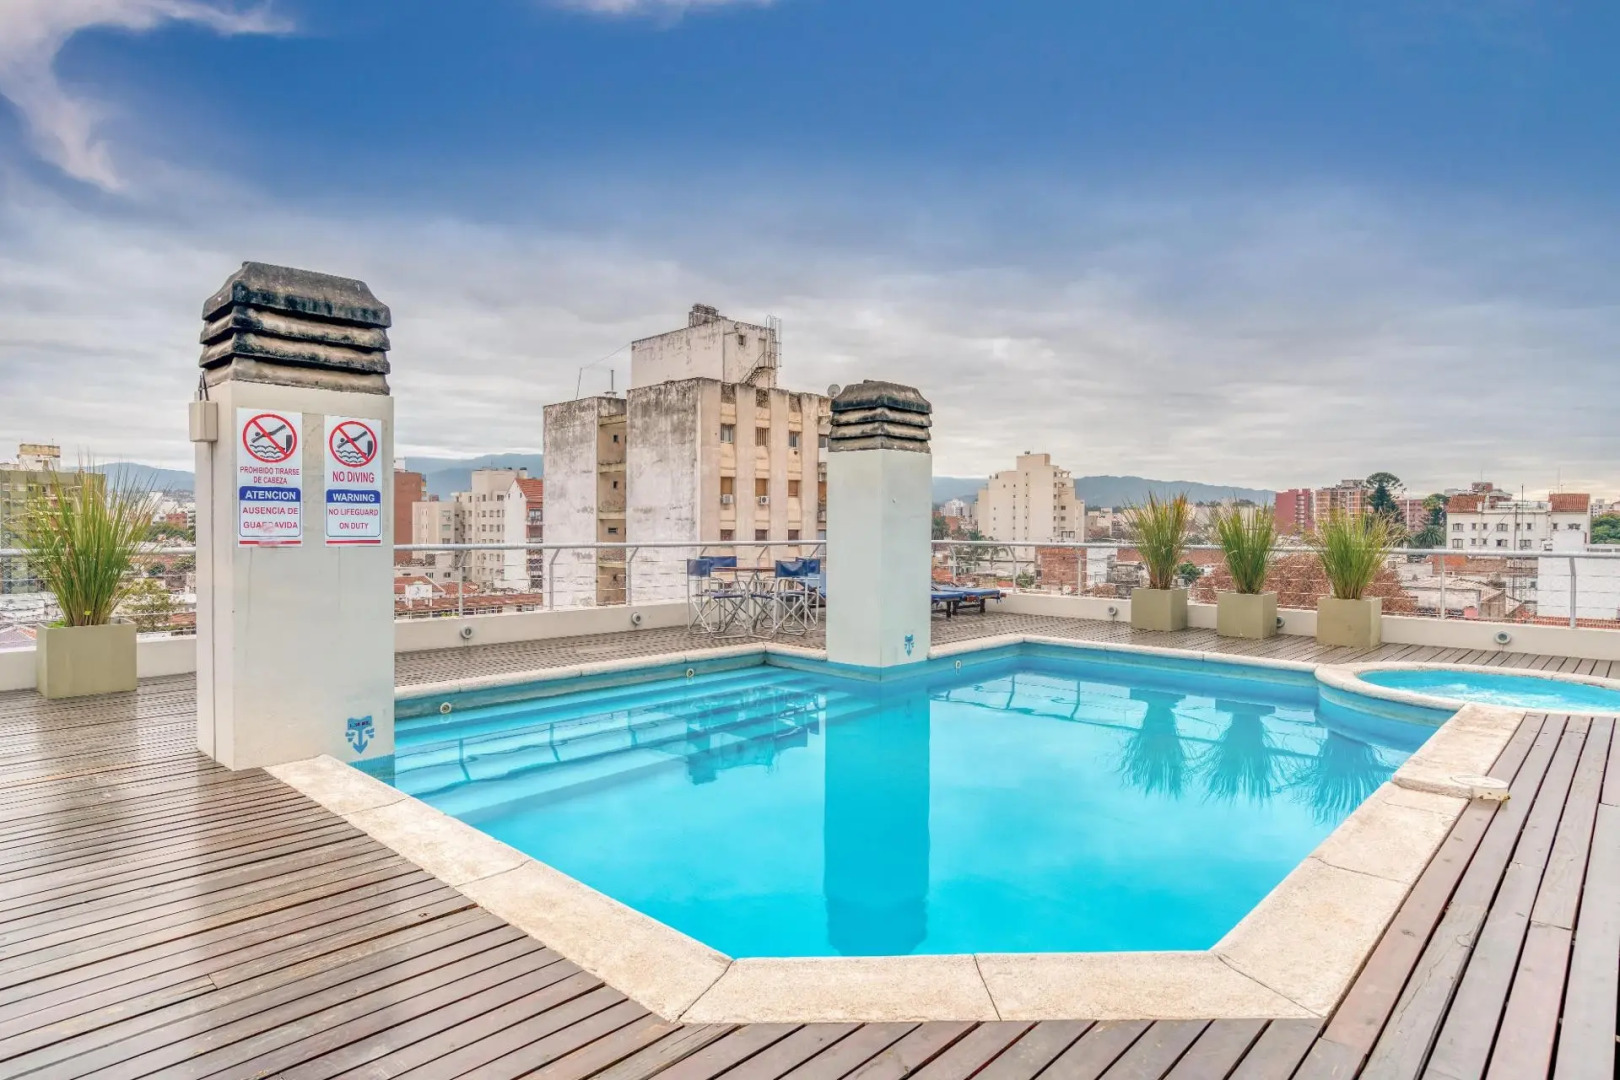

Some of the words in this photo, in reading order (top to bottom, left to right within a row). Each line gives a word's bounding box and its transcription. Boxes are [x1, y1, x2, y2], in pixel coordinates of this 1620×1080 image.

[240, 466, 274, 474] PROHIBIDO
[275, 467, 300, 476] TIRARSE
[253, 476, 262, 484] DE
[263, 476, 288, 485] CABEZA
[332, 471, 345, 482] NO
[347, 471, 375, 483] DIVING
[245, 490, 296, 500] ATENCION
[332, 493, 376, 502] WARNING
[242, 507, 286, 515] AUSENCIA
[287, 507, 299, 515] DE
[328, 508, 339, 516] NO
[340, 508, 379, 516] LIFEGUARD
[339, 522, 349, 530] ON
[351, 522, 369, 530] DUTY
